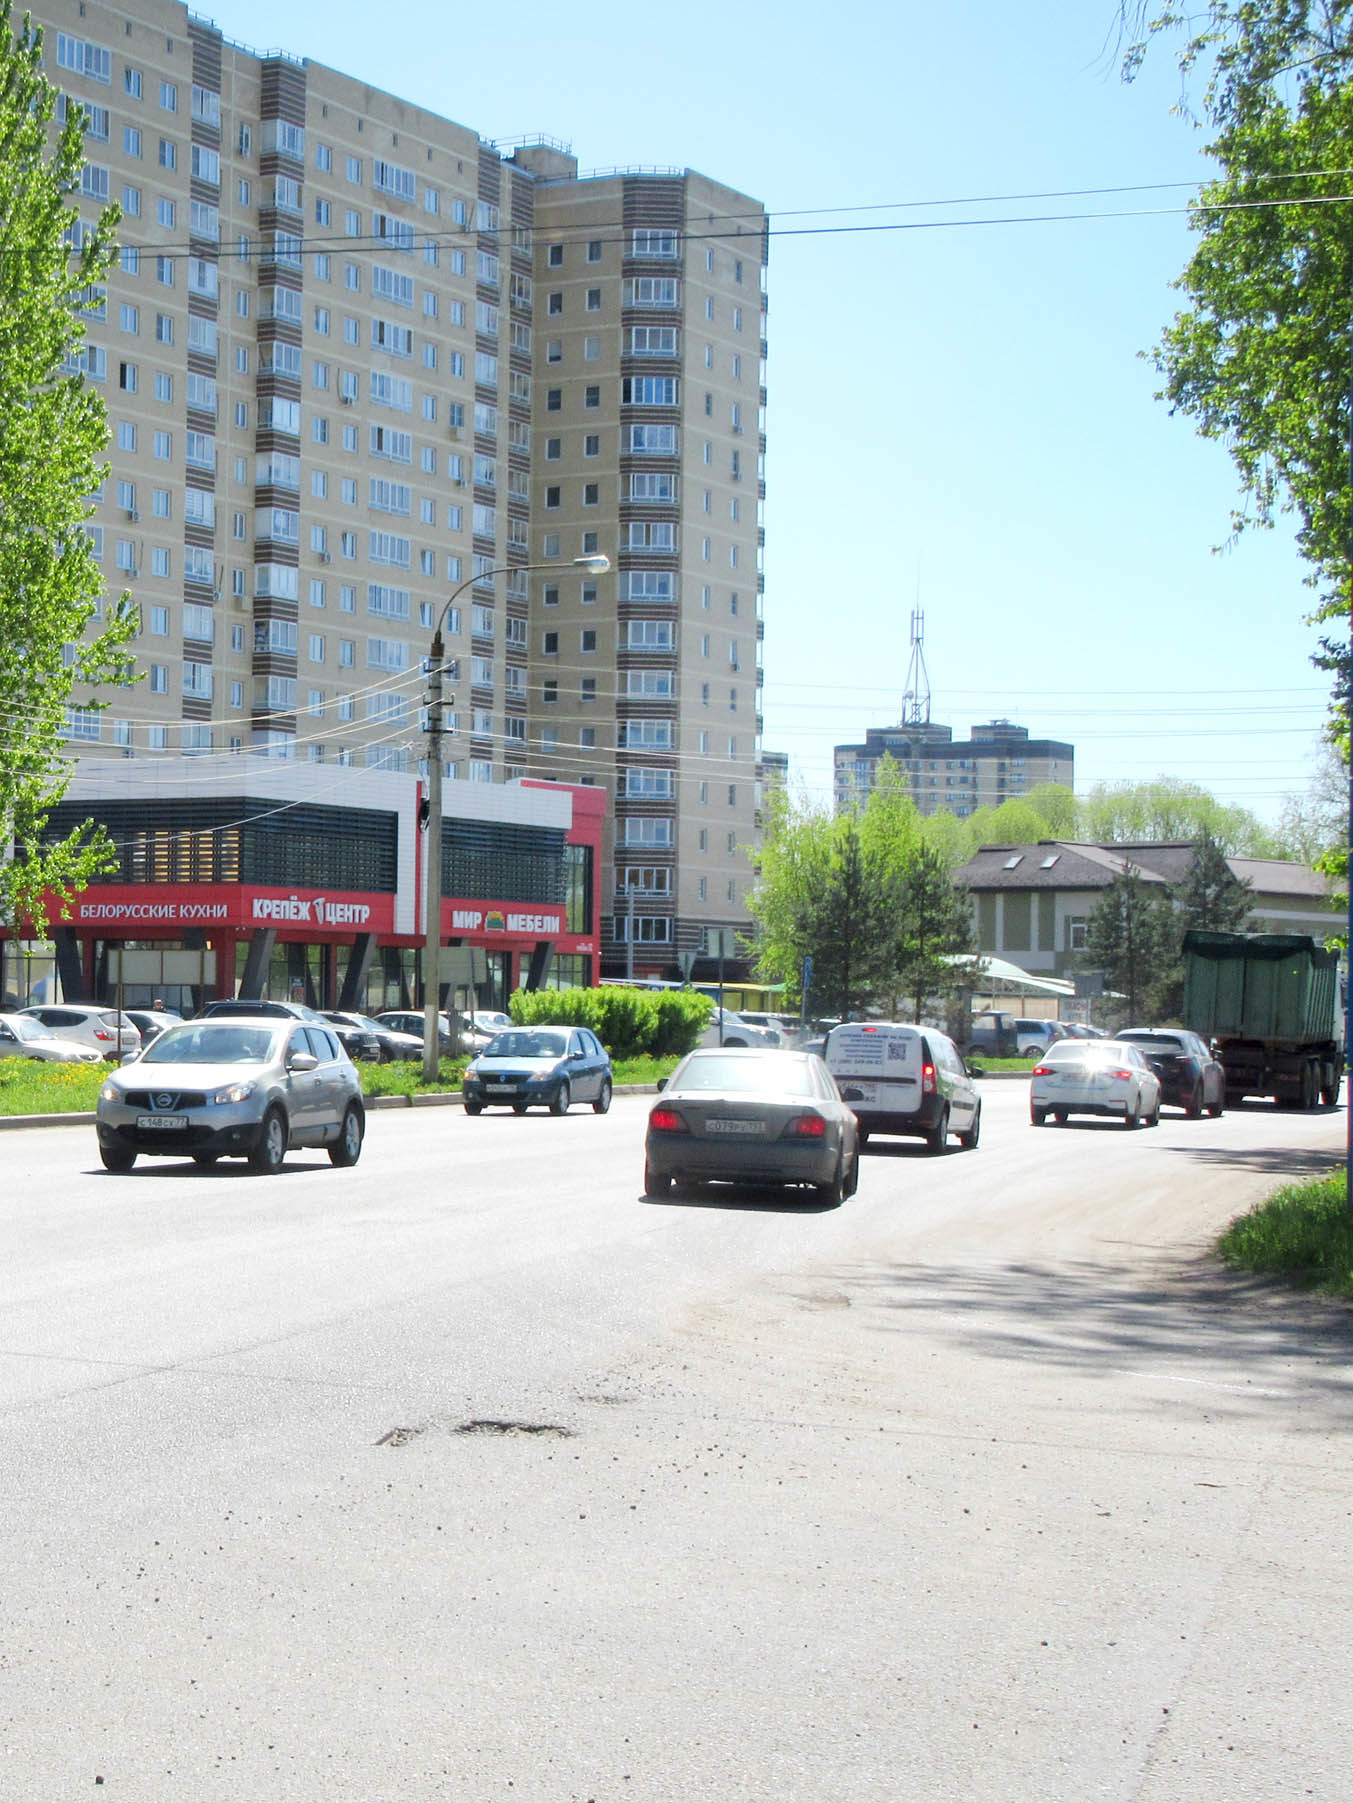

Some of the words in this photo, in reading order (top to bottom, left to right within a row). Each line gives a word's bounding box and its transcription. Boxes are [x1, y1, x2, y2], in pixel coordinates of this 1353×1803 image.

[80, 904, 177, 918] БЕЛОРУССКИЕ
[179, 904, 227, 918] КУХНИ
[252, 895, 311, 921] КРЕПЁЖ
[325, 902, 370, 925] ЦЕНТР
[452, 910, 482, 930] МИР
[506, 914, 560, 933] МЕБЕЛИ
